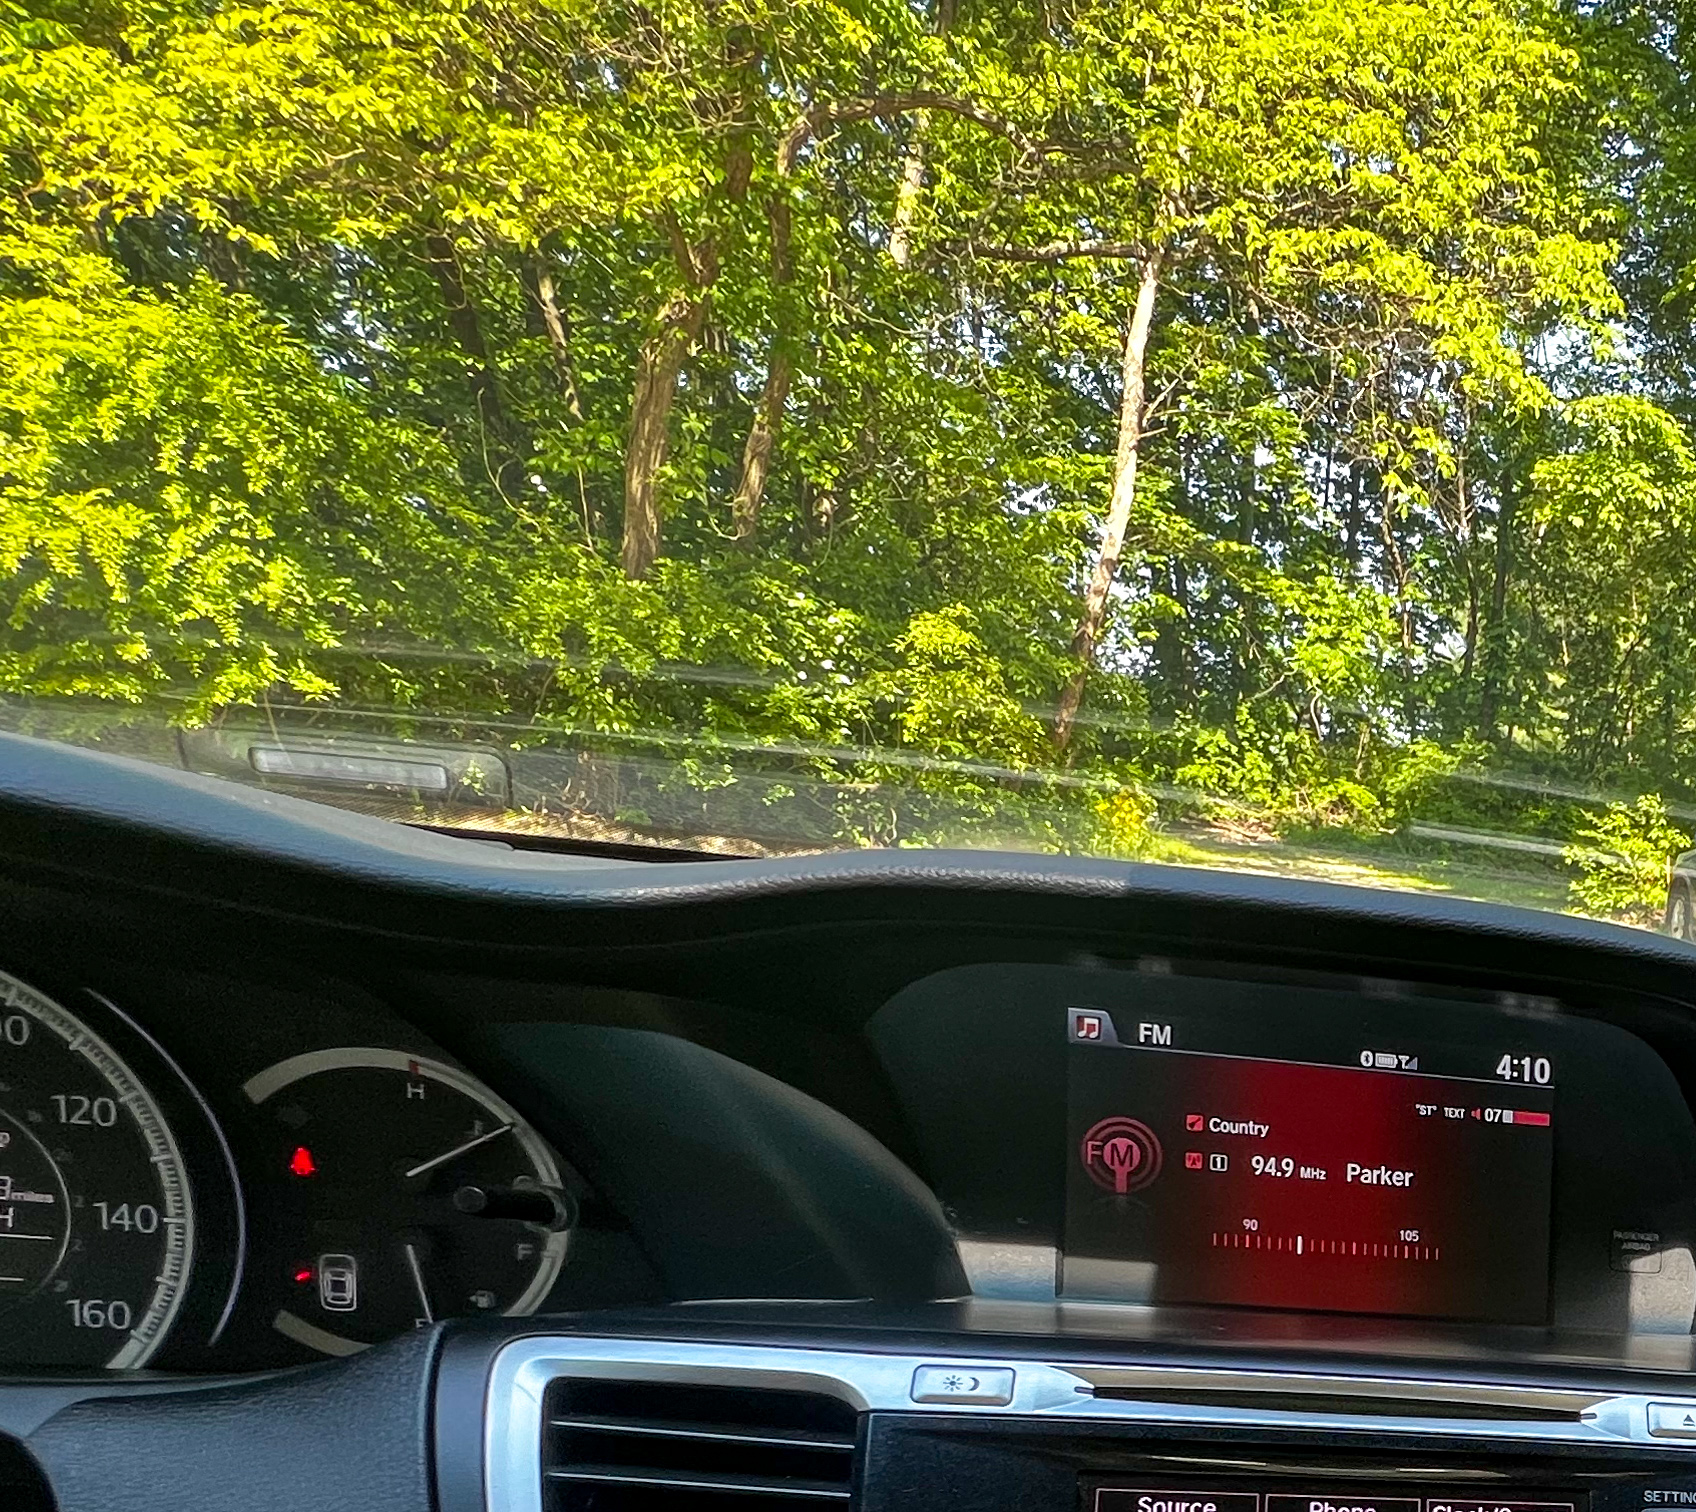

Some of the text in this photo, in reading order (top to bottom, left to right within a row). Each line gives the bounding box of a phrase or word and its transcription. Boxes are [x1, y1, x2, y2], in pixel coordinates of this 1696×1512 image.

[1139, 1022, 1172, 1046] FM
[1496, 1054, 1551, 1084] 4:10
[406, 1082, 425, 1100] H
[51, 1095, 117, 1127] 120
[1444, 1107, 1466, 1119] TEXT
[1484, 1108, 1501, 1123] 07
[1208, 1118, 1270, 1138] Country
[1251, 1155, 1295, 1178] 94.9
[1300, 1166, 1327, 1180] MHz
[1346, 1163, 1414, 1187] Parker
[92, 1202, 158, 1234] 140
[1242, 1218, 1259, 1231] 90
[1400, 1230, 1420, 1242] 105
[66, 1299, 131, 1329] 160
